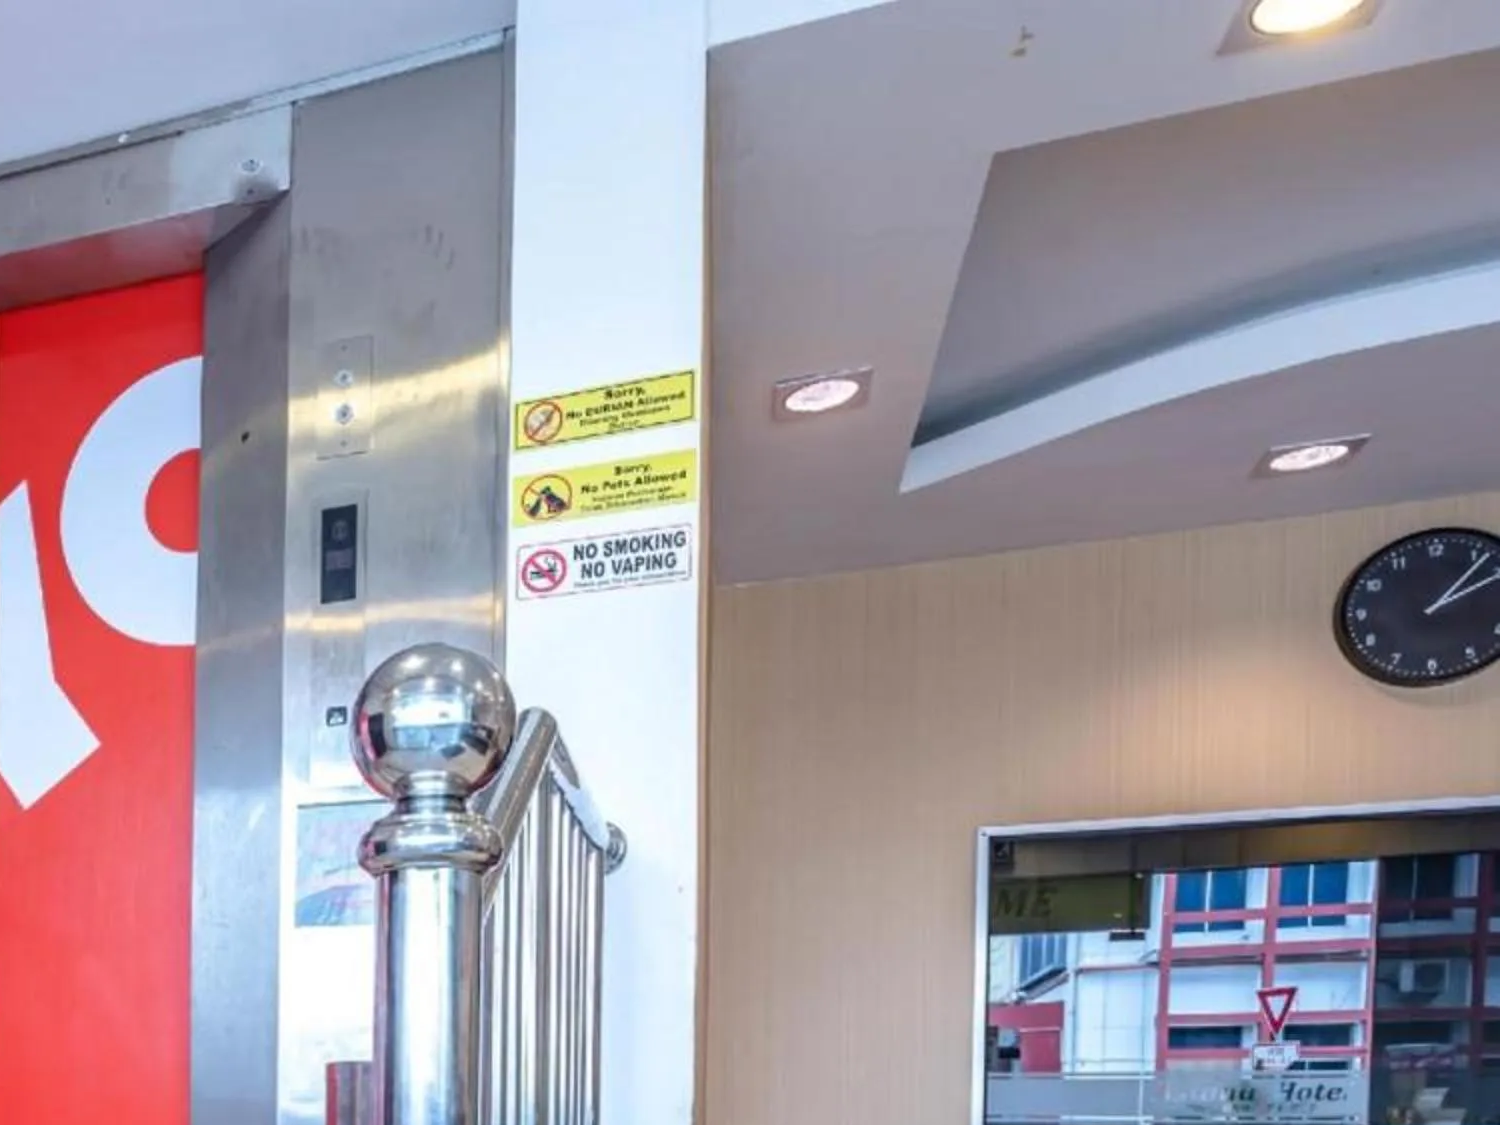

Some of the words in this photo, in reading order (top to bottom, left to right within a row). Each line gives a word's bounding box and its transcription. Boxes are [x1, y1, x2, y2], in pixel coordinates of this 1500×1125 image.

[580, 484, 598, 494] No
[602, 479, 630, 491] Pets
[634, 470, 687, 486] Allowed
[574, 542, 598, 561] NO
[603, 531, 687, 558] SMOKING
[581, 562, 605, 579] NO
[611, 551, 678, 575] VAPING
[1392, 556, 1406, 570] 11
[1390, 653, 1402, 665] 7
[1464, 646, 1476, 660] 5
